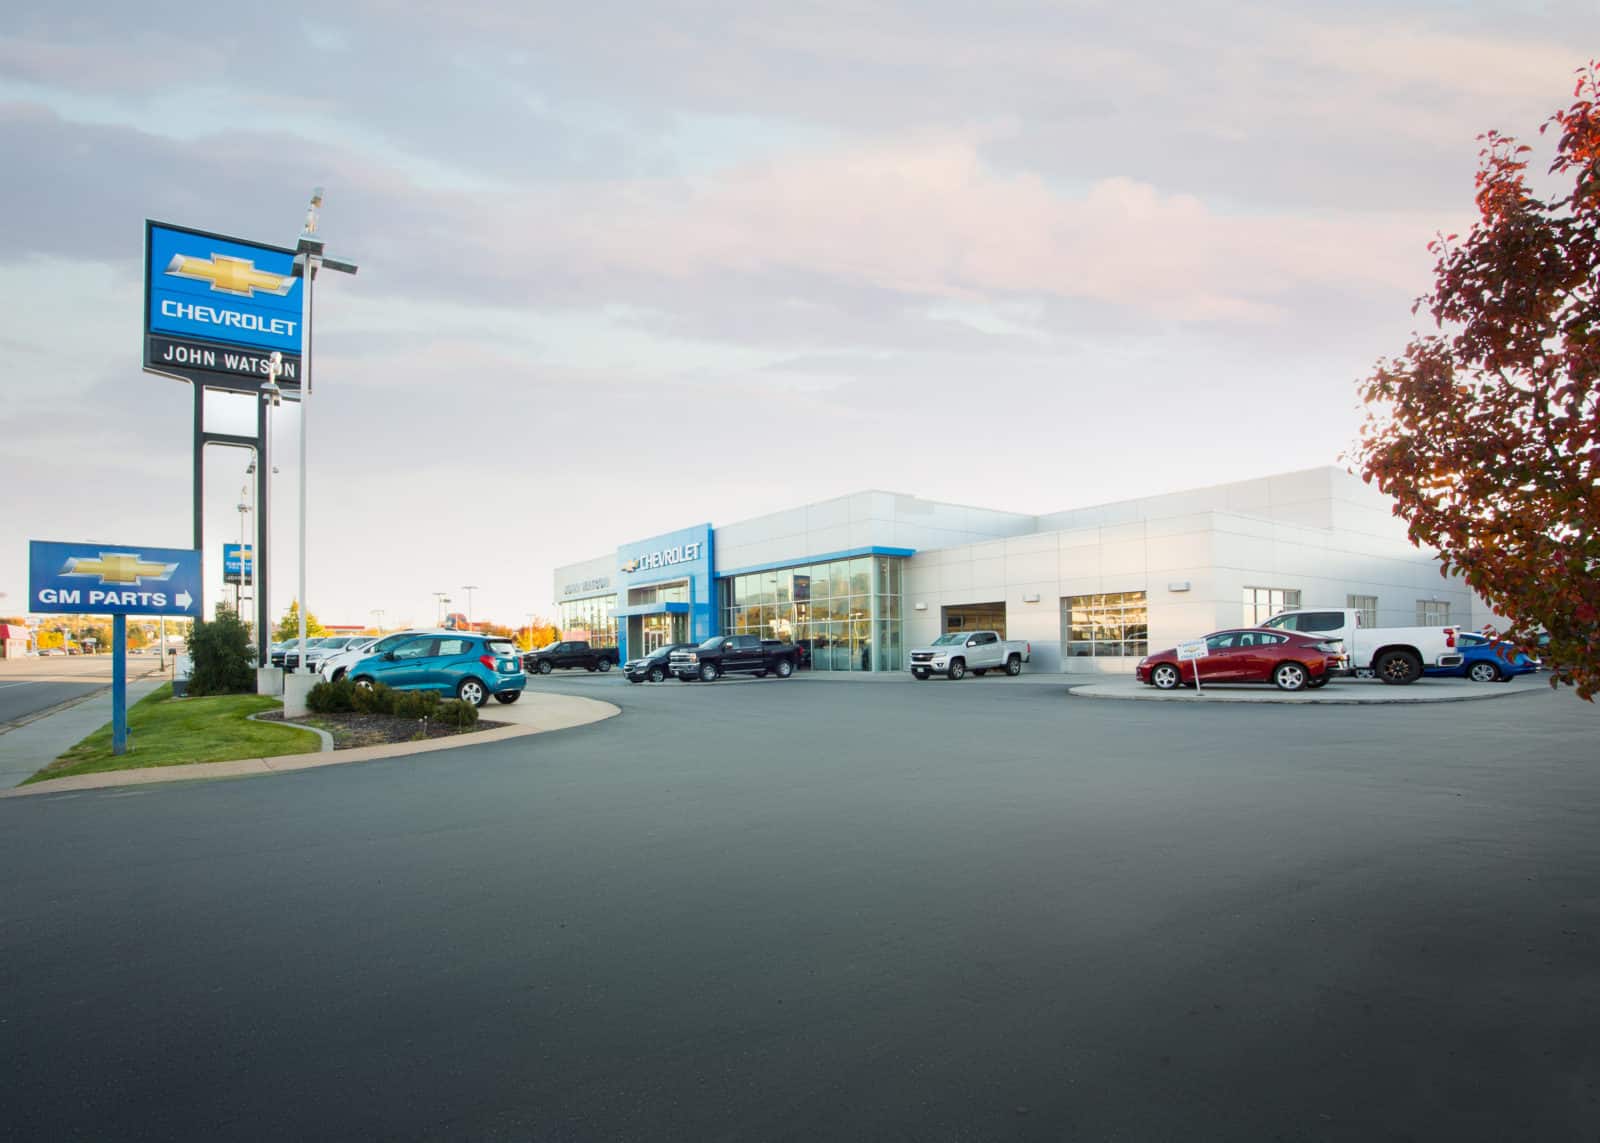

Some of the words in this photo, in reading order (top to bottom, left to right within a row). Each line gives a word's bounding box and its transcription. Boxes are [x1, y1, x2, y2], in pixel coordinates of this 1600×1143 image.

[161, 299, 297, 337] CHEVROLET
[163, 345, 216, 367] JOHN
[640, 542, 701, 570] CHEVROLET
[38, 589, 81, 604] GM
[89, 591, 167, 606] PARTS
